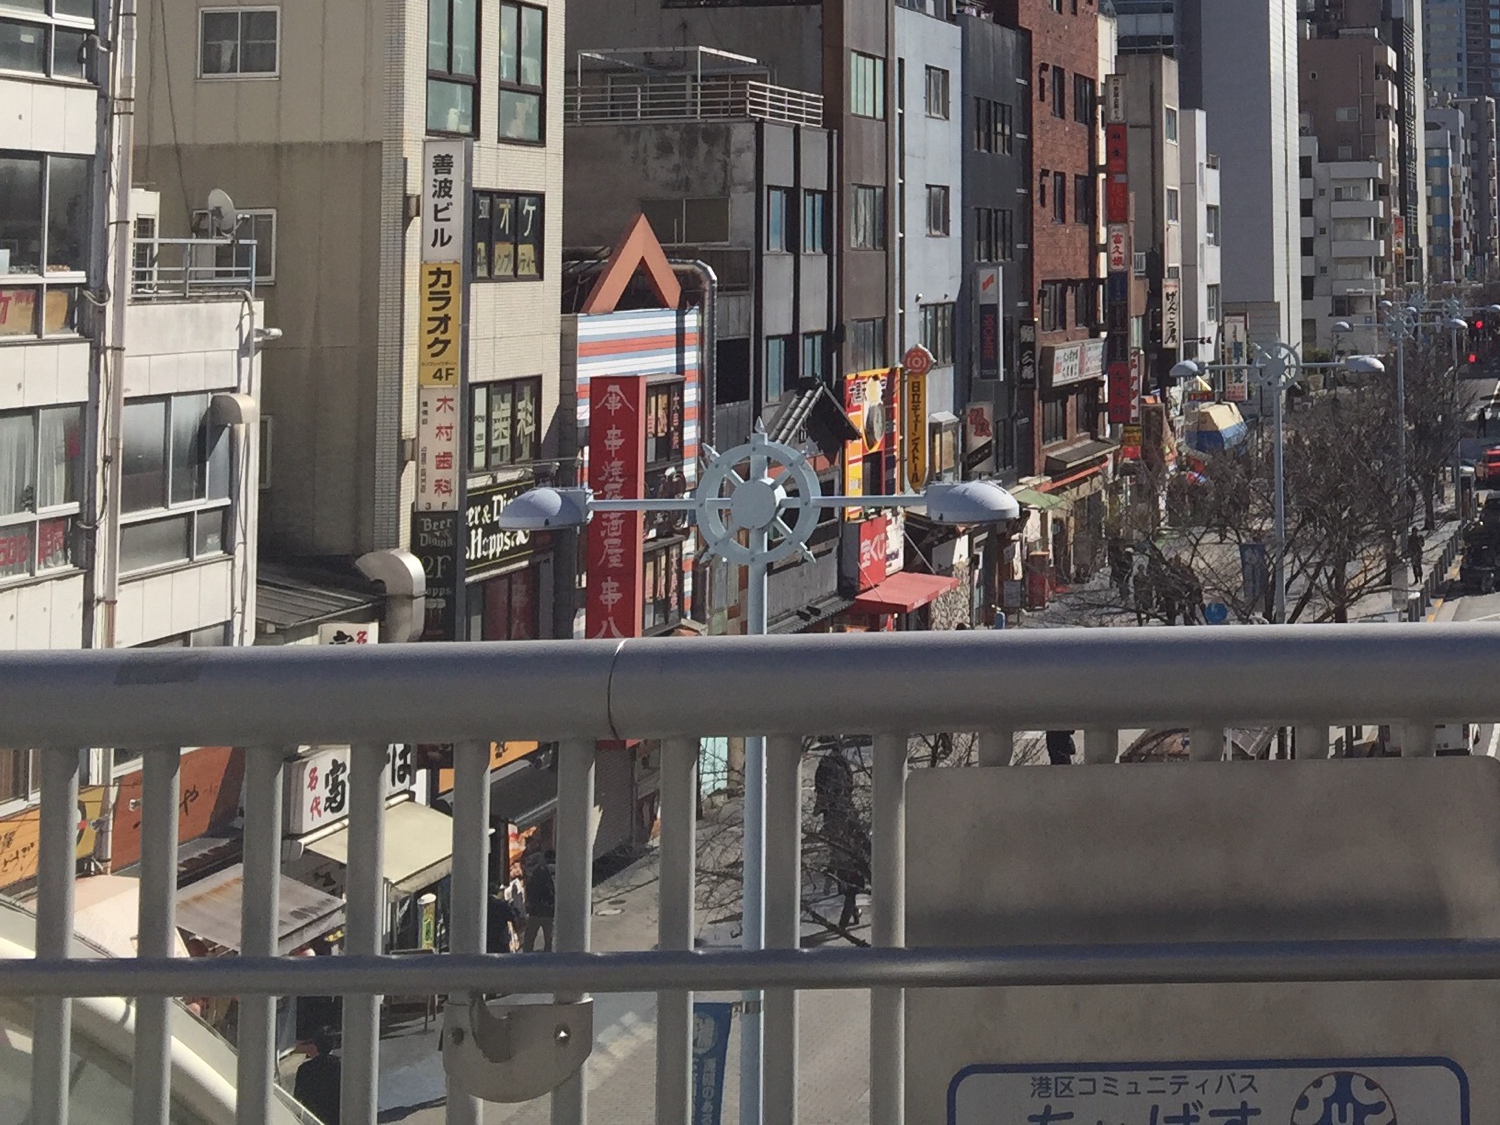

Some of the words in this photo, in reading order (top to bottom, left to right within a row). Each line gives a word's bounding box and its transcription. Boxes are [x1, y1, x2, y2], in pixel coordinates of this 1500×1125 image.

[432, 154, 454, 249] 善波ビル
[427, 267, 452, 358] カラオケ
[432, 367, 456, 382] 4F
[434, 395, 455, 497] 木村歯科
[1030, 1074, 1259, 1098] 港区コミュニティバス
